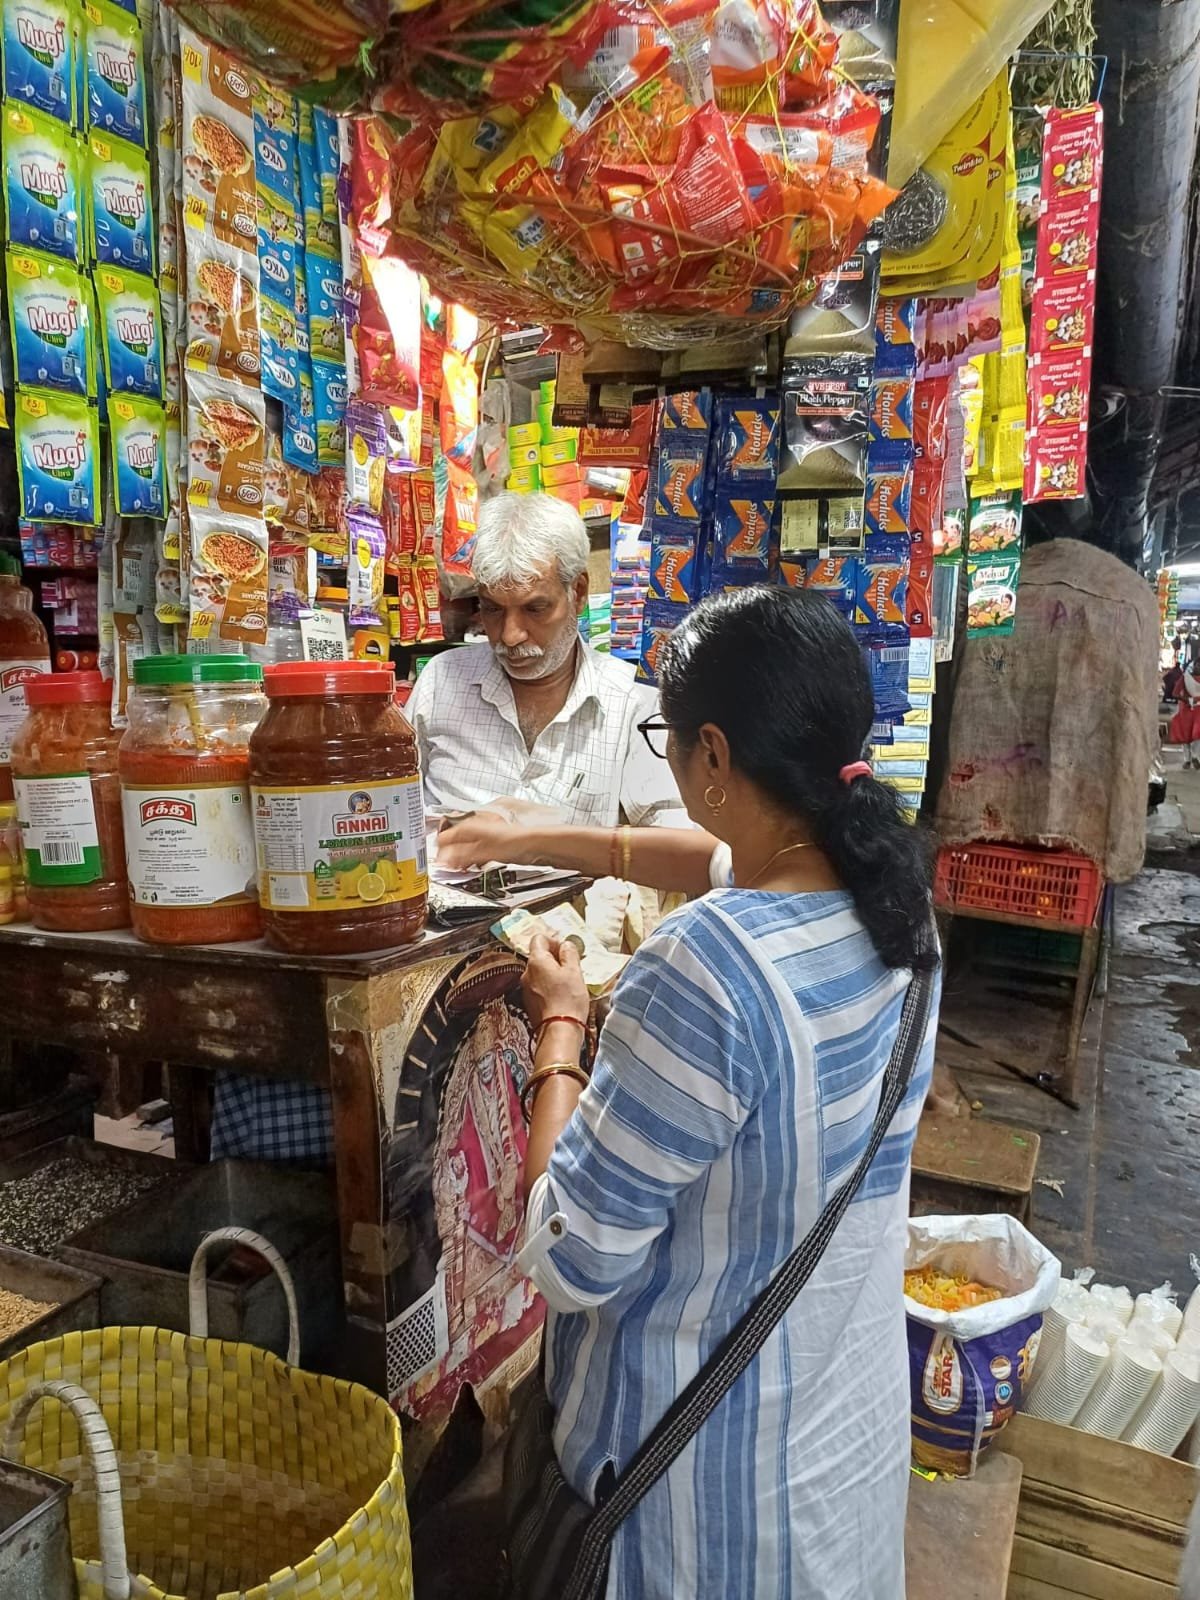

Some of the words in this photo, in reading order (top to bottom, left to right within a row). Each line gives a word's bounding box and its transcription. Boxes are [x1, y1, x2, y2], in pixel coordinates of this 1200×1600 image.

[17, 18, 65, 58] Mugi
[97, 50, 136, 87] Mugi
[21, 161, 68, 199] Mugi
[104, 184, 145, 220] Mugi
[1048, 221, 1070, 230] Ginger
[27, 298, 78, 337] Mugi
[1044, 297, 1065, 306] Ginger
[1066, 293, 1085, 303] Garlic
[117, 312, 155, 346] Mugi
[1040, 373, 1062, 382] Ginger
[1062, 370, 1082, 379] Garlic
[881, 391, 895, 438] Horlicks
[33, 430, 87, 470] Mugi
[127, 432, 158, 468] Mugi
[748, 413, 763, 457] Horlicks
[915, 447, 923, 458] 5
[1038, 446, 1059, 454] Ginger
[1059, 444, 1078, 452] Garlic
[672, 472, 687, 514] Horlicks
[879, 485, 892, 531] Horlicks
[744, 502, 758, 545] Horlicks
[914, 532, 922, 543] 5
[664, 556, 678, 599] Horlicks
[876, 576, 890, 620] Horlicks
[320, 613, 333, 624] Pay
[913, 612, 923, 624] 5
[318, 837, 364, 849] LEMON
[336, 816, 386, 835] ANNAI
[941, 1354, 953, 1398] STAR
